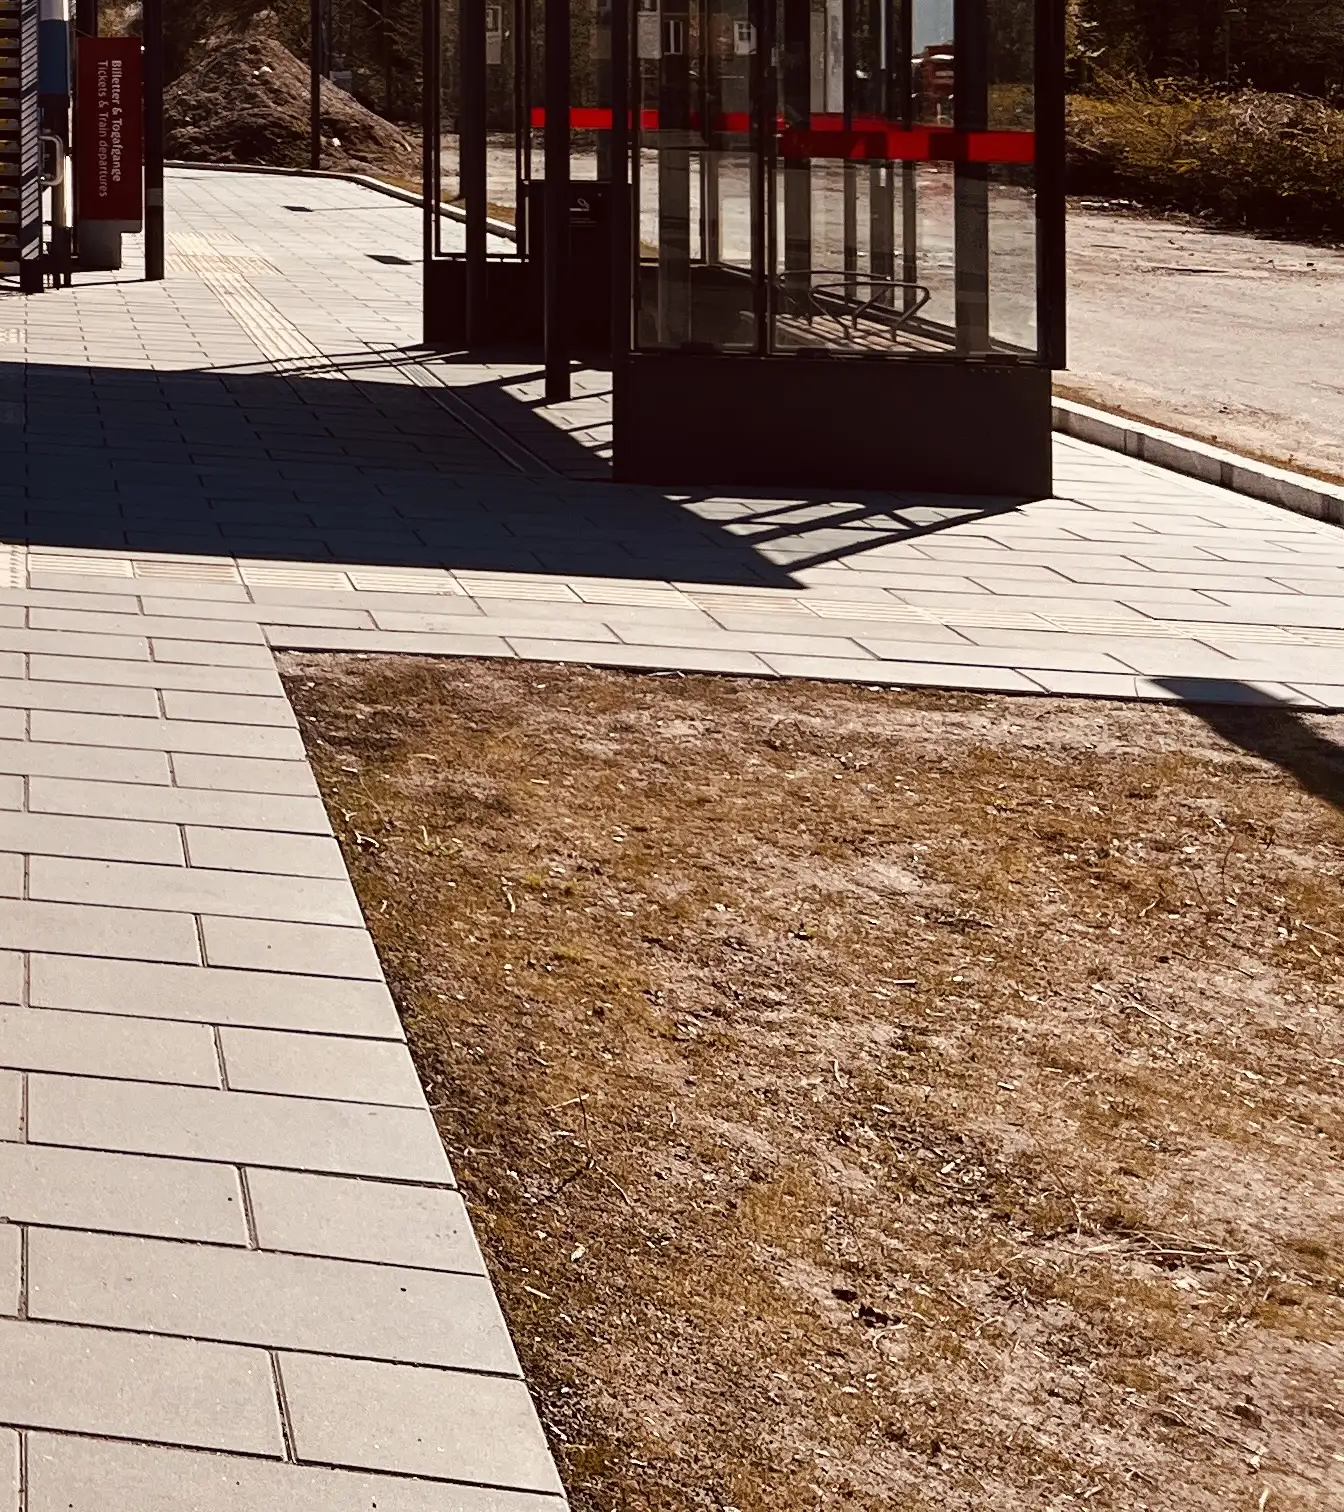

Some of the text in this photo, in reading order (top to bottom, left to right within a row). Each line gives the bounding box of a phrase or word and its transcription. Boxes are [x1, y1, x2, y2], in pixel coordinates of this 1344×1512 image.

[98, 60, 109, 197] Tickets & Train departures
[110, 60, 123, 182] Billetter & Togafgange
